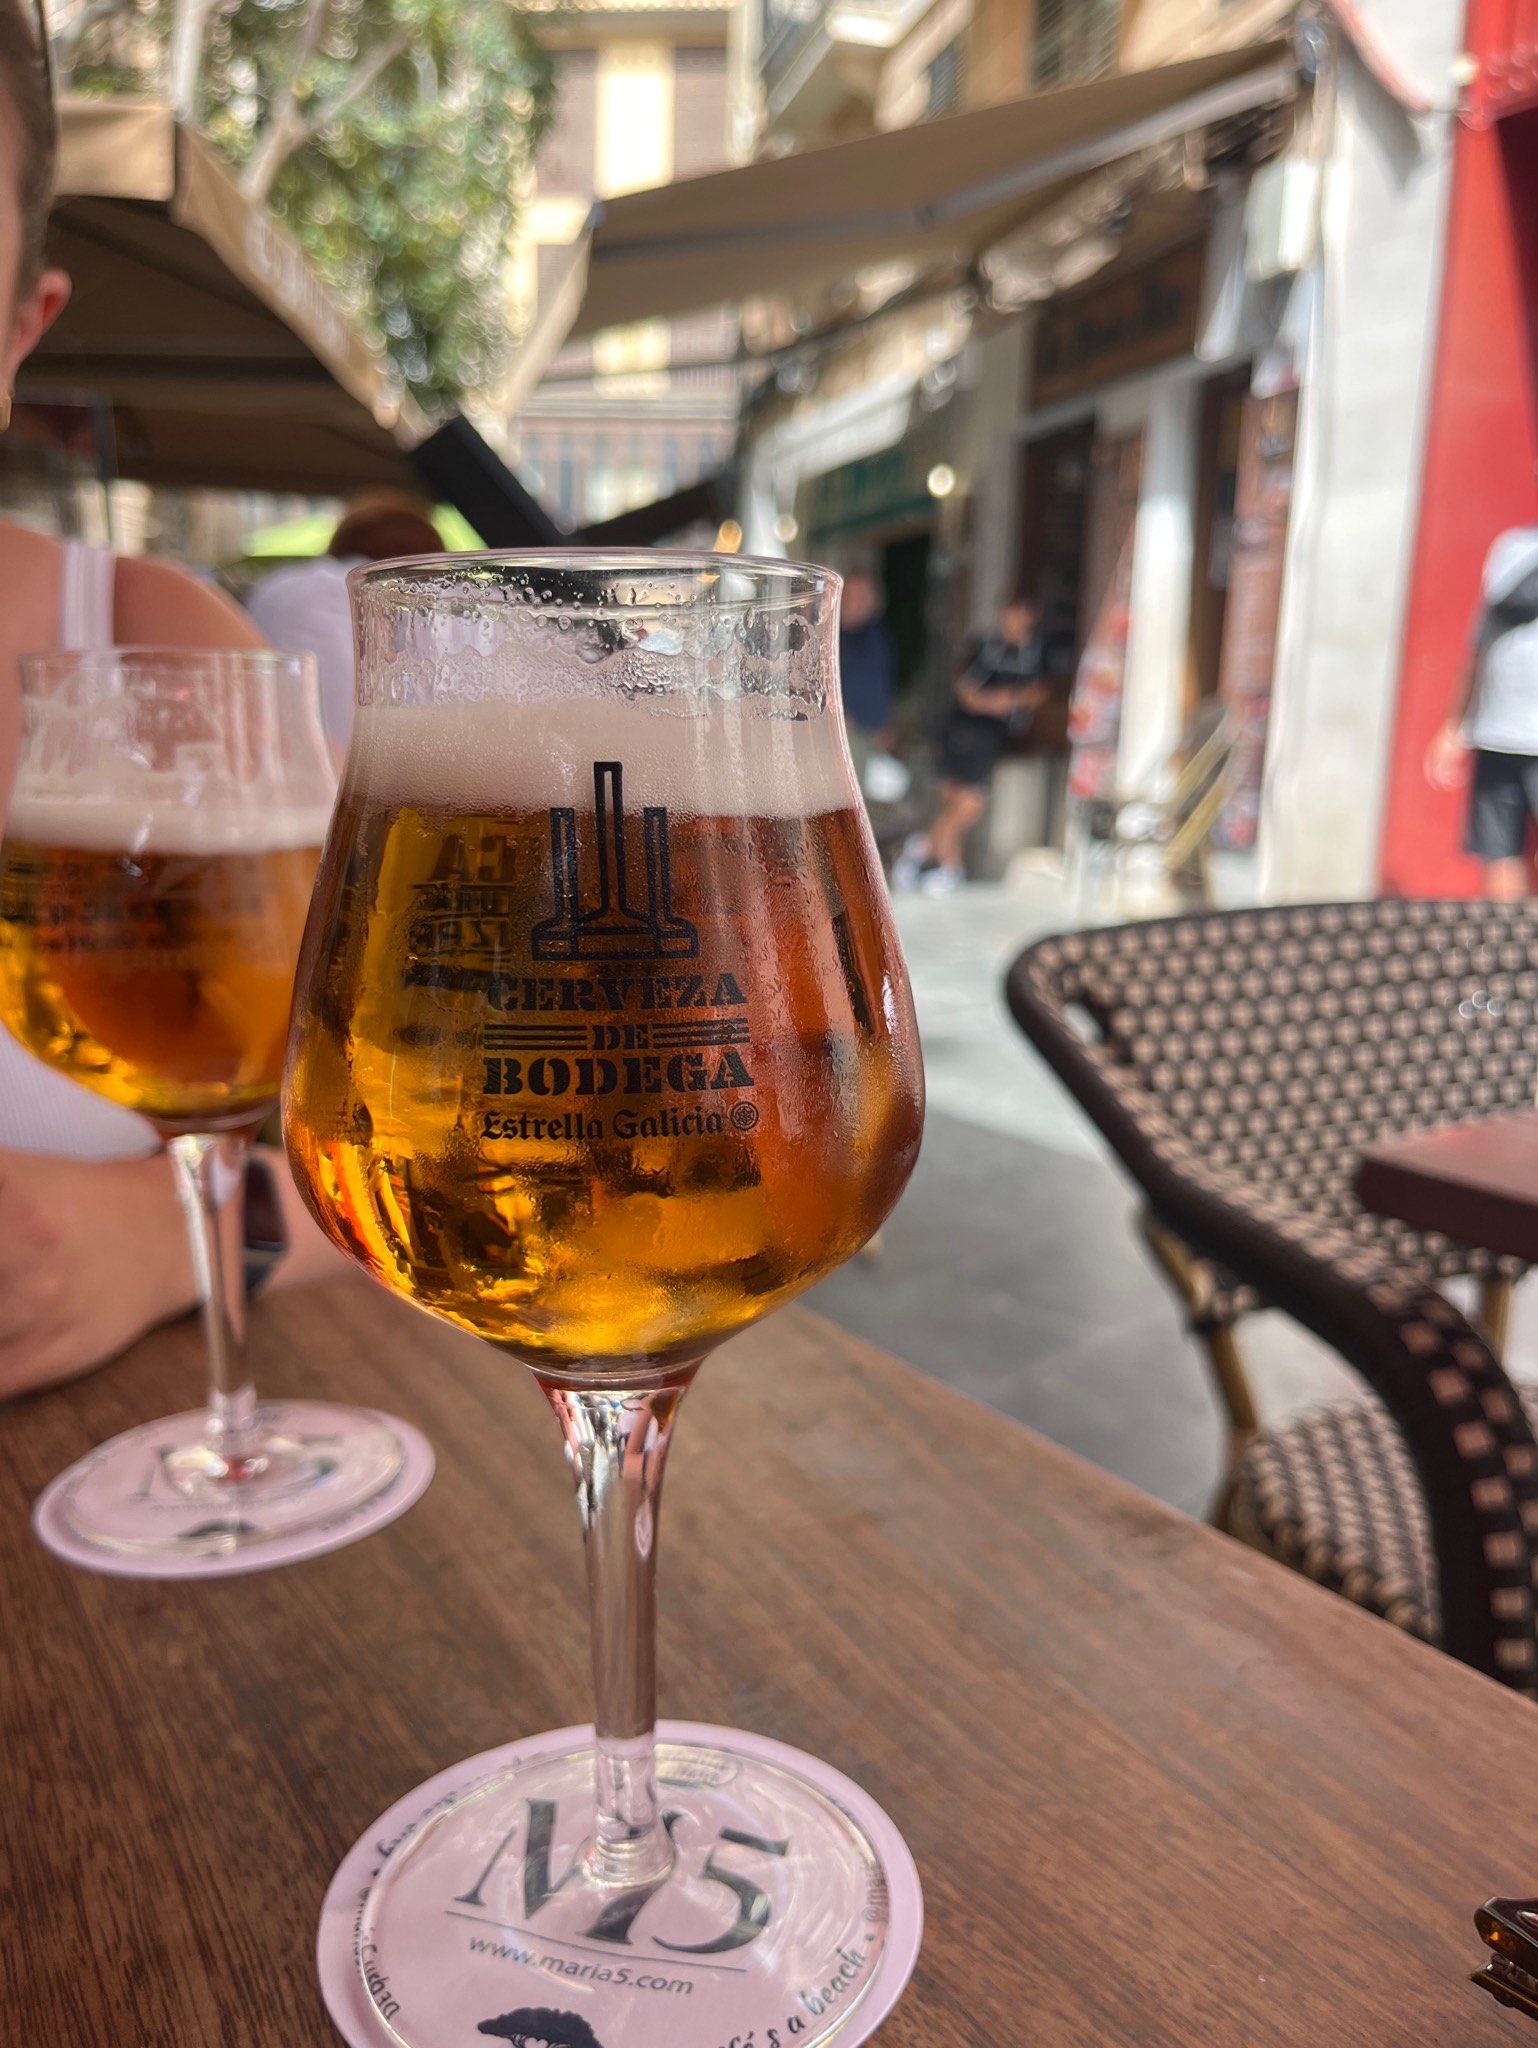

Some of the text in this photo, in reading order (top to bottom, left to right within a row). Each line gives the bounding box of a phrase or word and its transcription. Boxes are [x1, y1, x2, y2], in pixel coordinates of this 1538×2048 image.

[486, 972, 748, 1011] CERVEZA
[592, 1023, 649, 1050] DE
[482, 1050, 755, 1096] BODEGA
[480, 1105, 723, 1141] Estrella Galicia
[468, 1934, 694, 1996] www.maria5.com
[800, 1945, 866, 2016] beach
